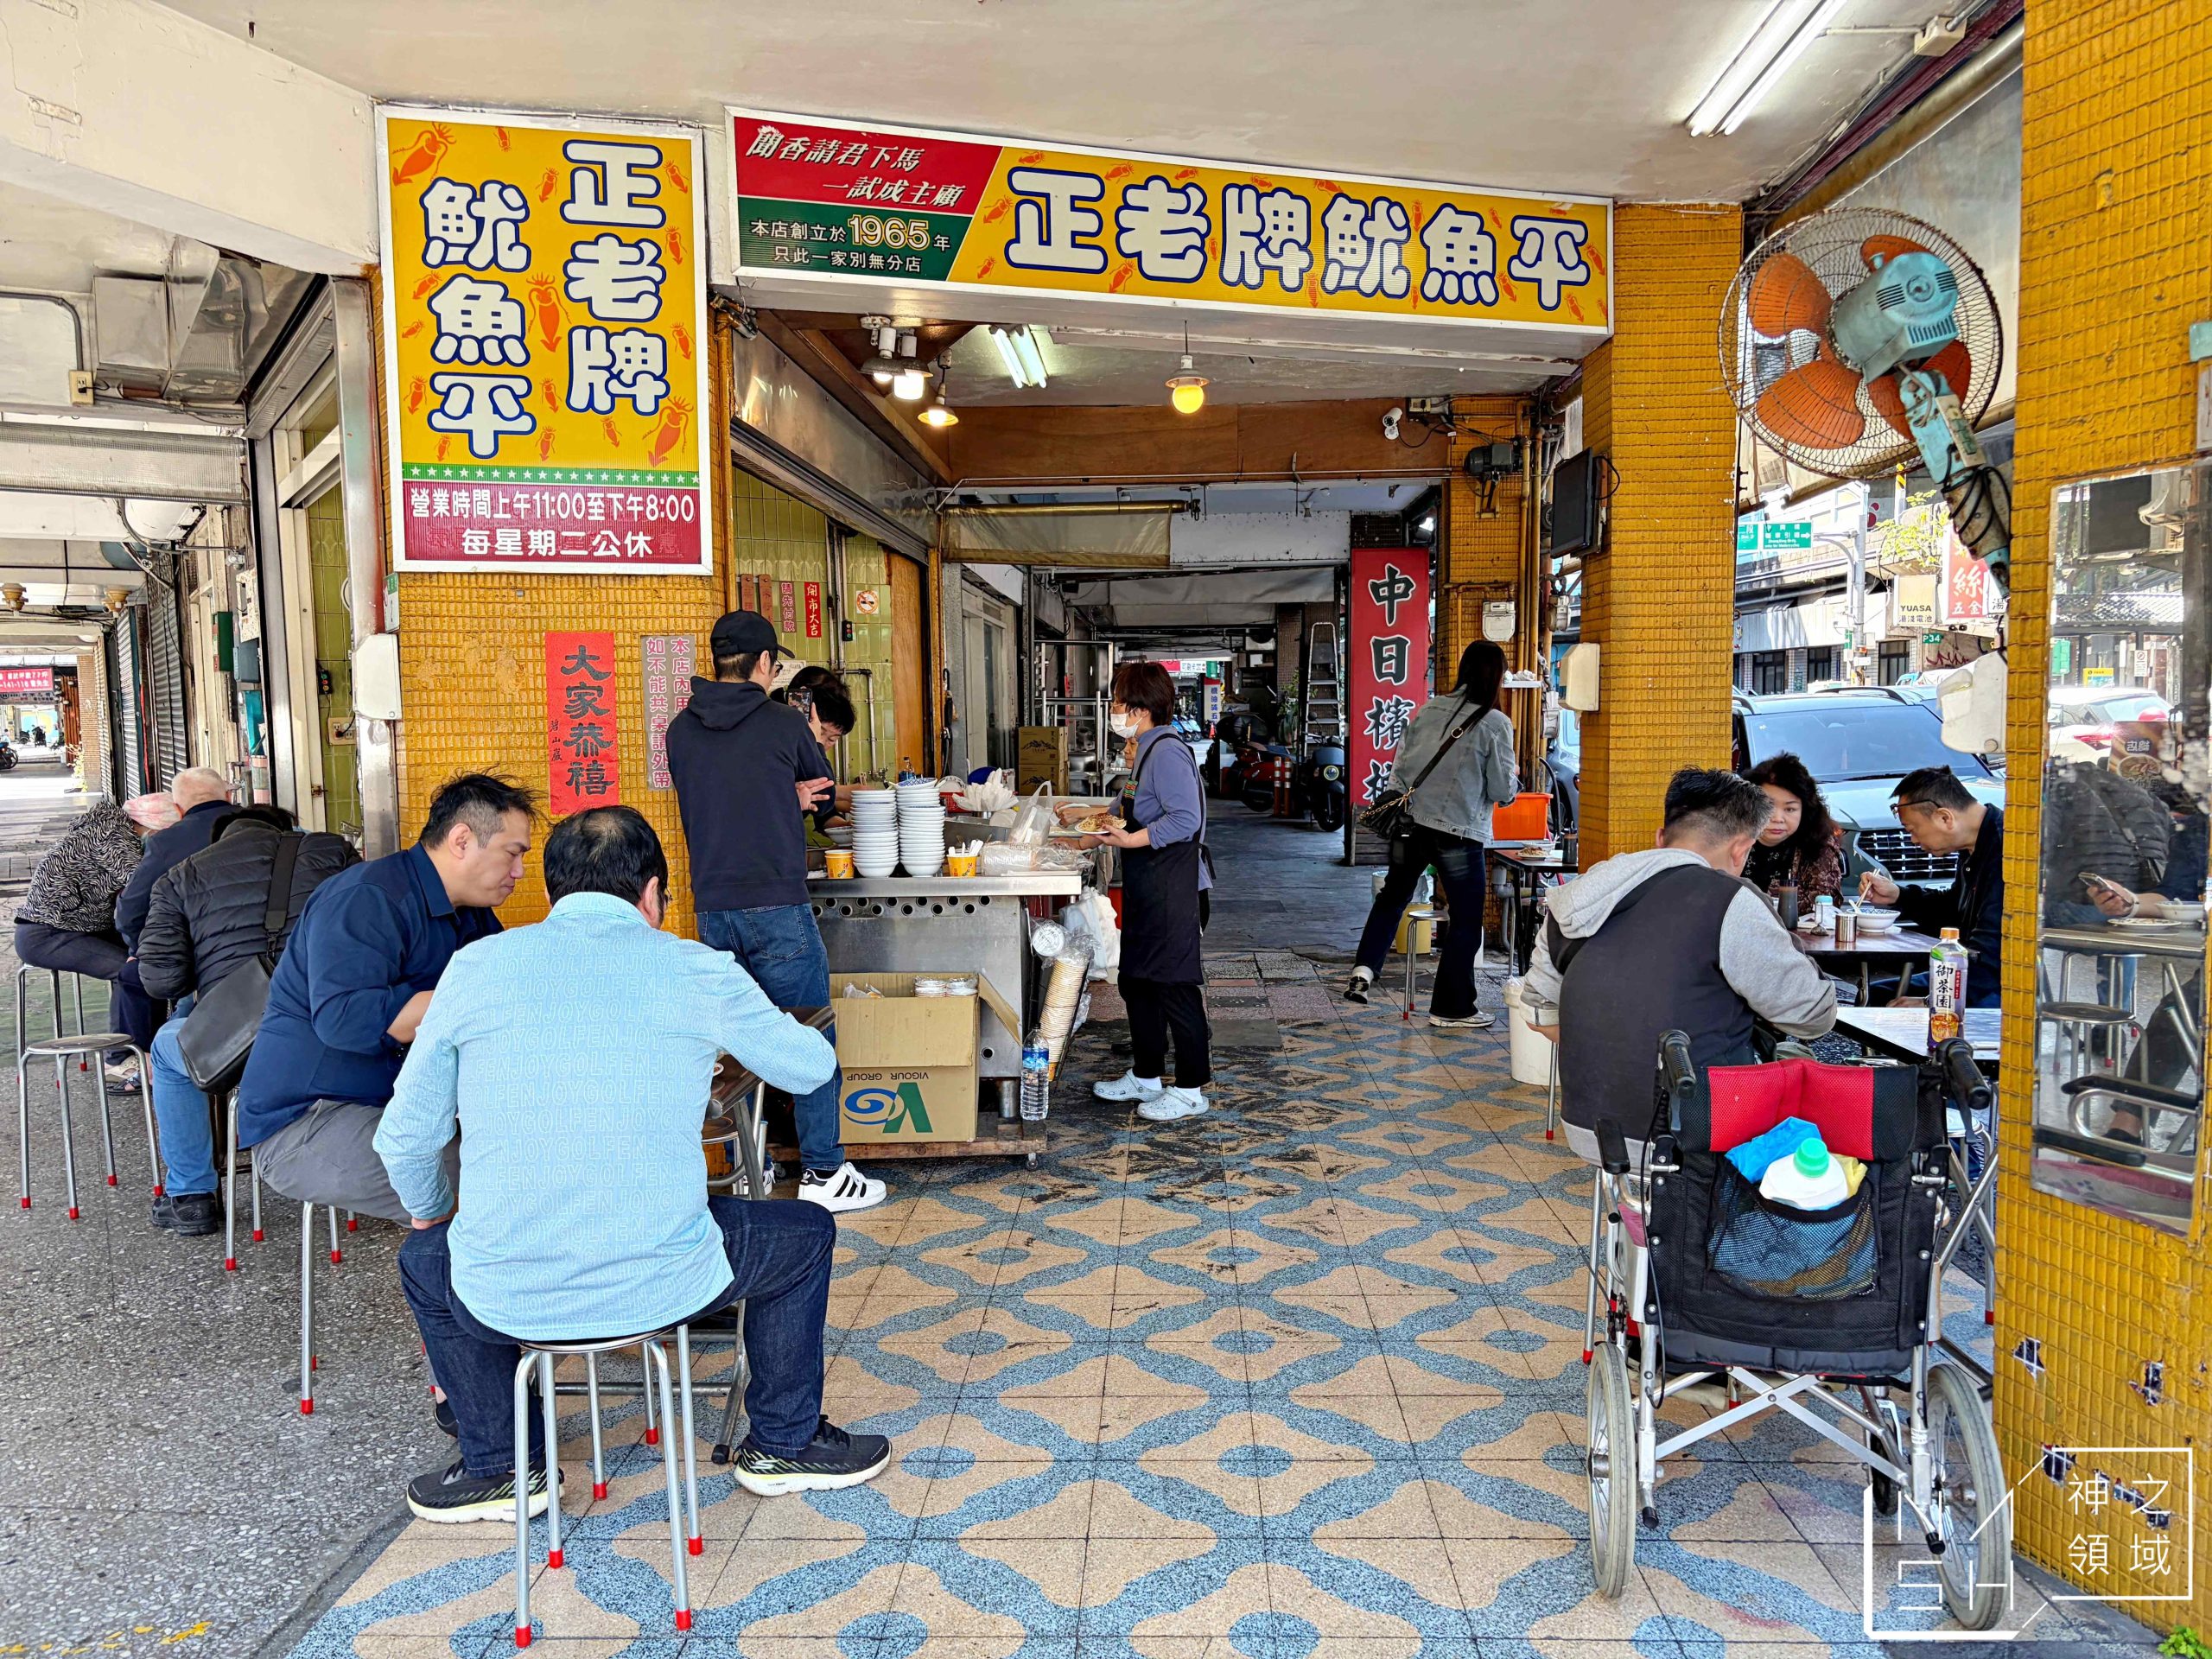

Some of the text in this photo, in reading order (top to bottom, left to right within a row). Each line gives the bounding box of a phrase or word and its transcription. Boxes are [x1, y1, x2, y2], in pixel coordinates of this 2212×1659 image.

[823, 176, 966, 207] 一試成主顧
[774, 245, 922, 273] 只此一家別無分店
[1005, 165, 1592, 311] 正老牌魷魚平
[559, 139, 671, 416] 正老牌
[419, 177, 537, 460] 魷魚平
[461, 528, 652, 558] 每星期二公休
[781, 582, 795, 632] 請先付款
[807, 583, 820, 636] 開市大吉
[1951, 601, 1983, 615] 五金
[1923, 634, 1941, 643] P34
[560, 645, 615, 796] 大家恭禧
[646, 638, 671, 788] 如不能共桌請外帶
[1936, 964, 1955, 1008] 御茶園
[846, 1071, 930, 1081] VIGOUR GROUP
